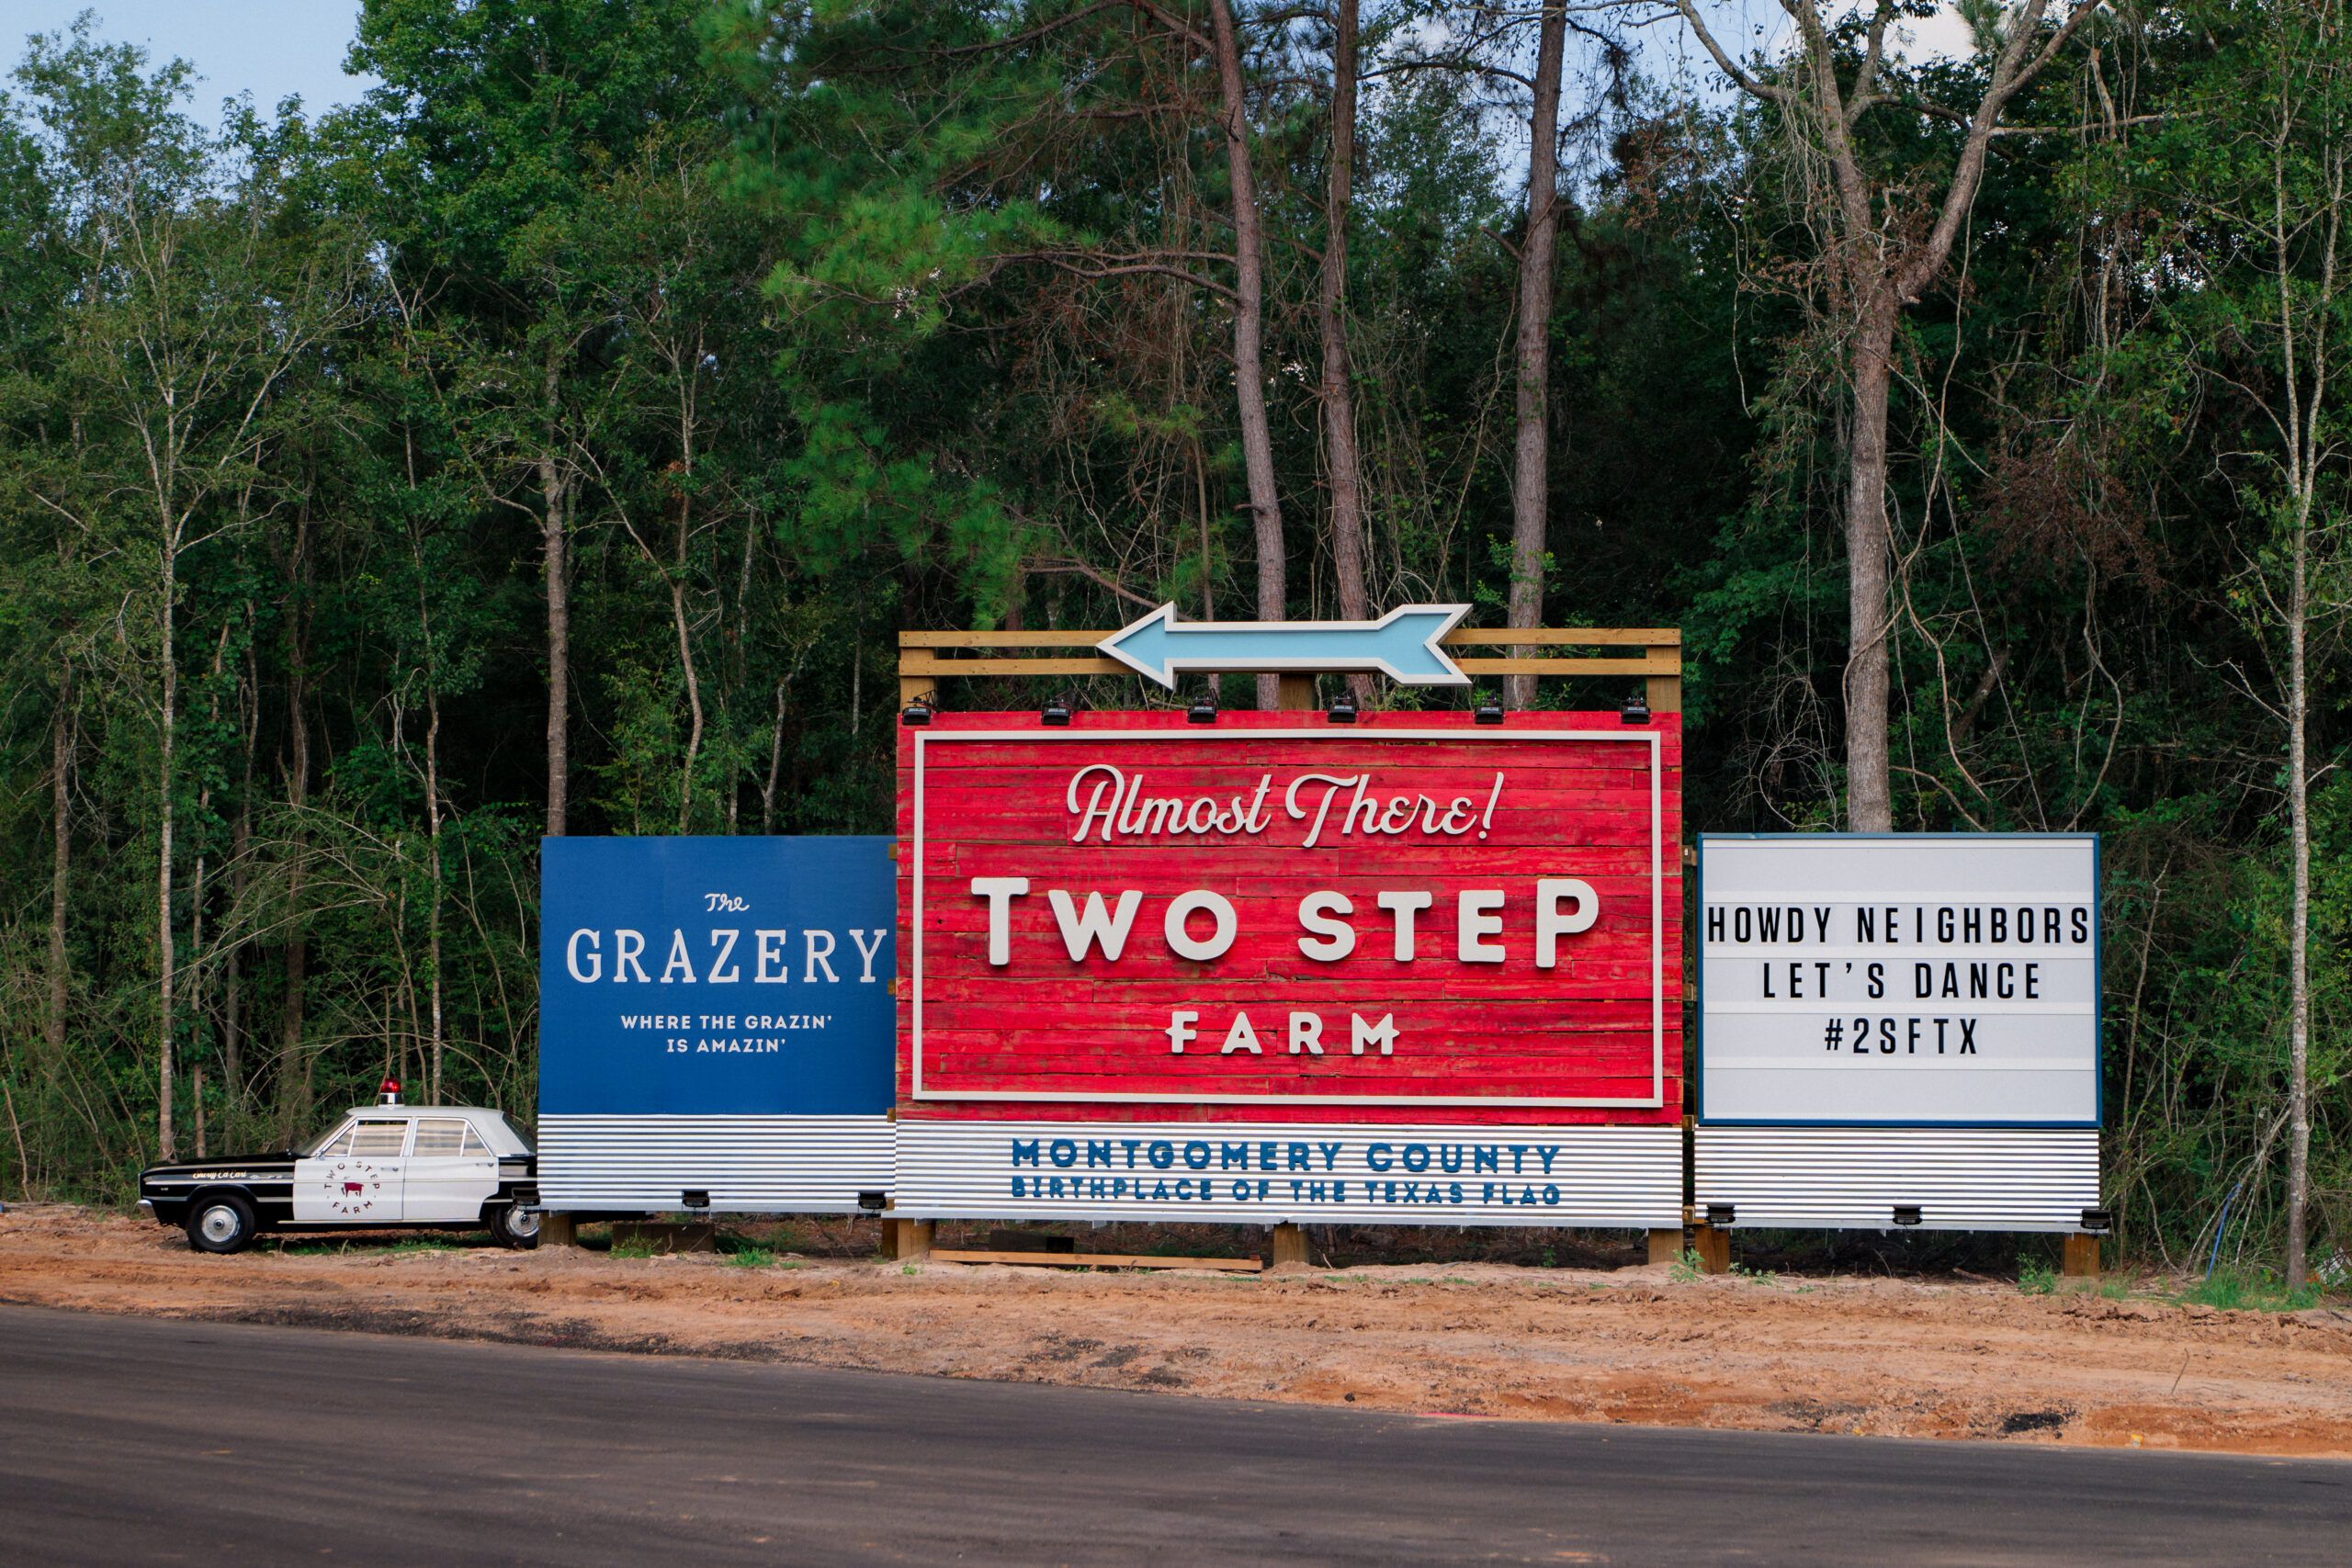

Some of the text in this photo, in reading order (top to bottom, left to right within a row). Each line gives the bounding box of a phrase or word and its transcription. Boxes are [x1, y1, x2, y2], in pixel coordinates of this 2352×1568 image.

[1067, 763, 1505, 848] Almost There!
[705, 893, 750, 912] The
[970, 876, 1600, 968] TWO STEP
[1707, 906, 2088, 944] HOWDY NEIGHBORS
[566, 928, 888, 984] GRAZERY
[1762, 962, 2040, 999] LET'S DANCE
[621, 1015, 832, 1030] WHERE THE GRAZIN'
[1164, 1010, 1401, 1055] FARM
[1824, 1018, 1978, 1055] #2SFTX
[666, 1039, 786, 1054] IS AMAZIN'
[1012, 1137, 1561, 1175] MONTGOMERY COUNTY
[323, 1160, 380, 1190] TWO STEP
[1012, 1175, 1561, 1205] BIRTHPLACE OF THE TEXAS FLAG
[332, 1200, 373, 1214] FARM
